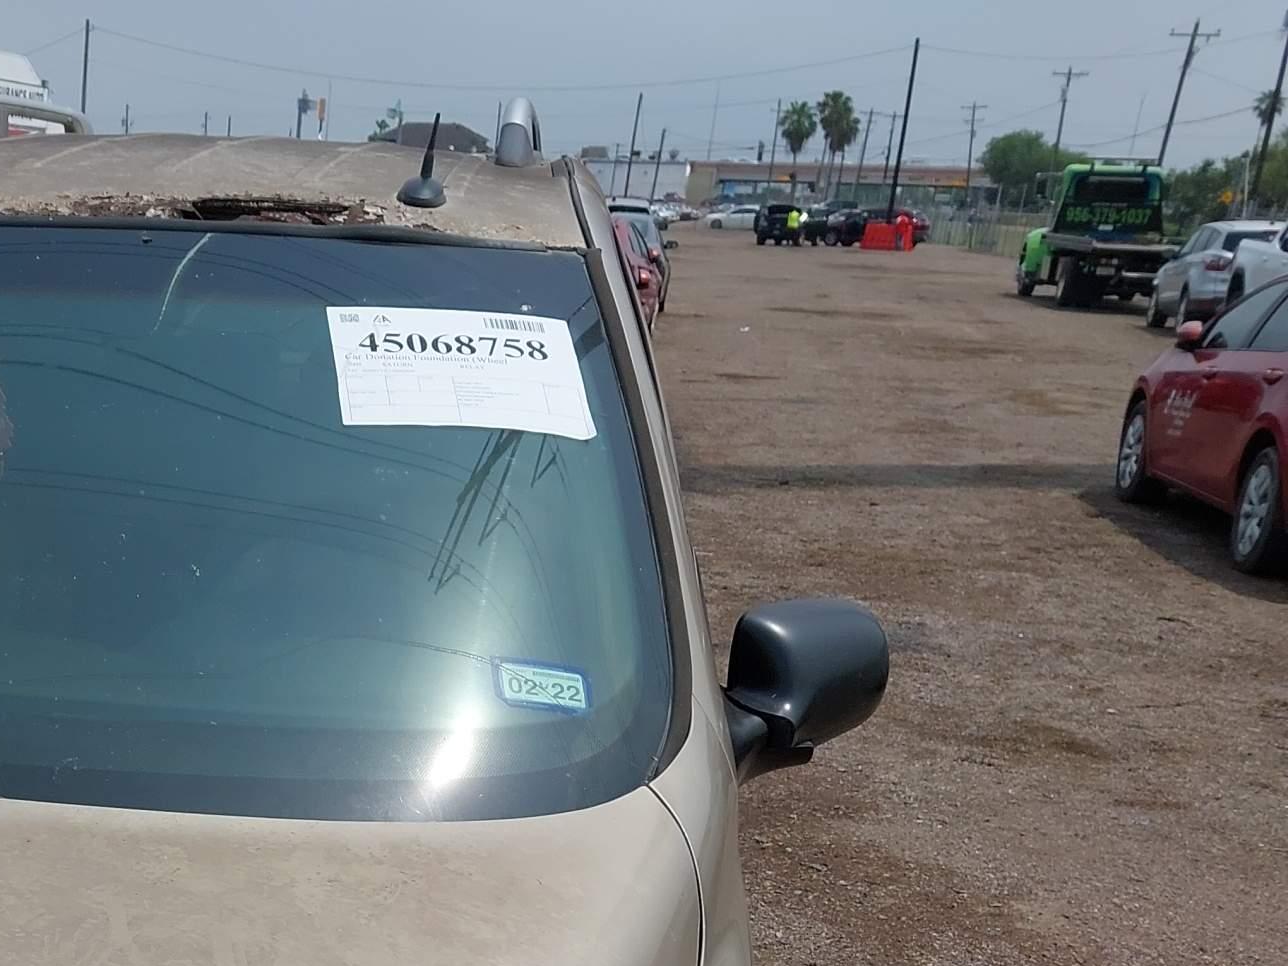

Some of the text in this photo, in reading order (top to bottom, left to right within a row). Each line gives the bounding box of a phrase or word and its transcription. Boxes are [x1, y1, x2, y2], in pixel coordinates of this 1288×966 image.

[358, 331, 550, 361] 45068758
[365, 352, 411, 362] Donation
[508, 676, 539, 695] 02
[551, 682, 582, 703] 22
